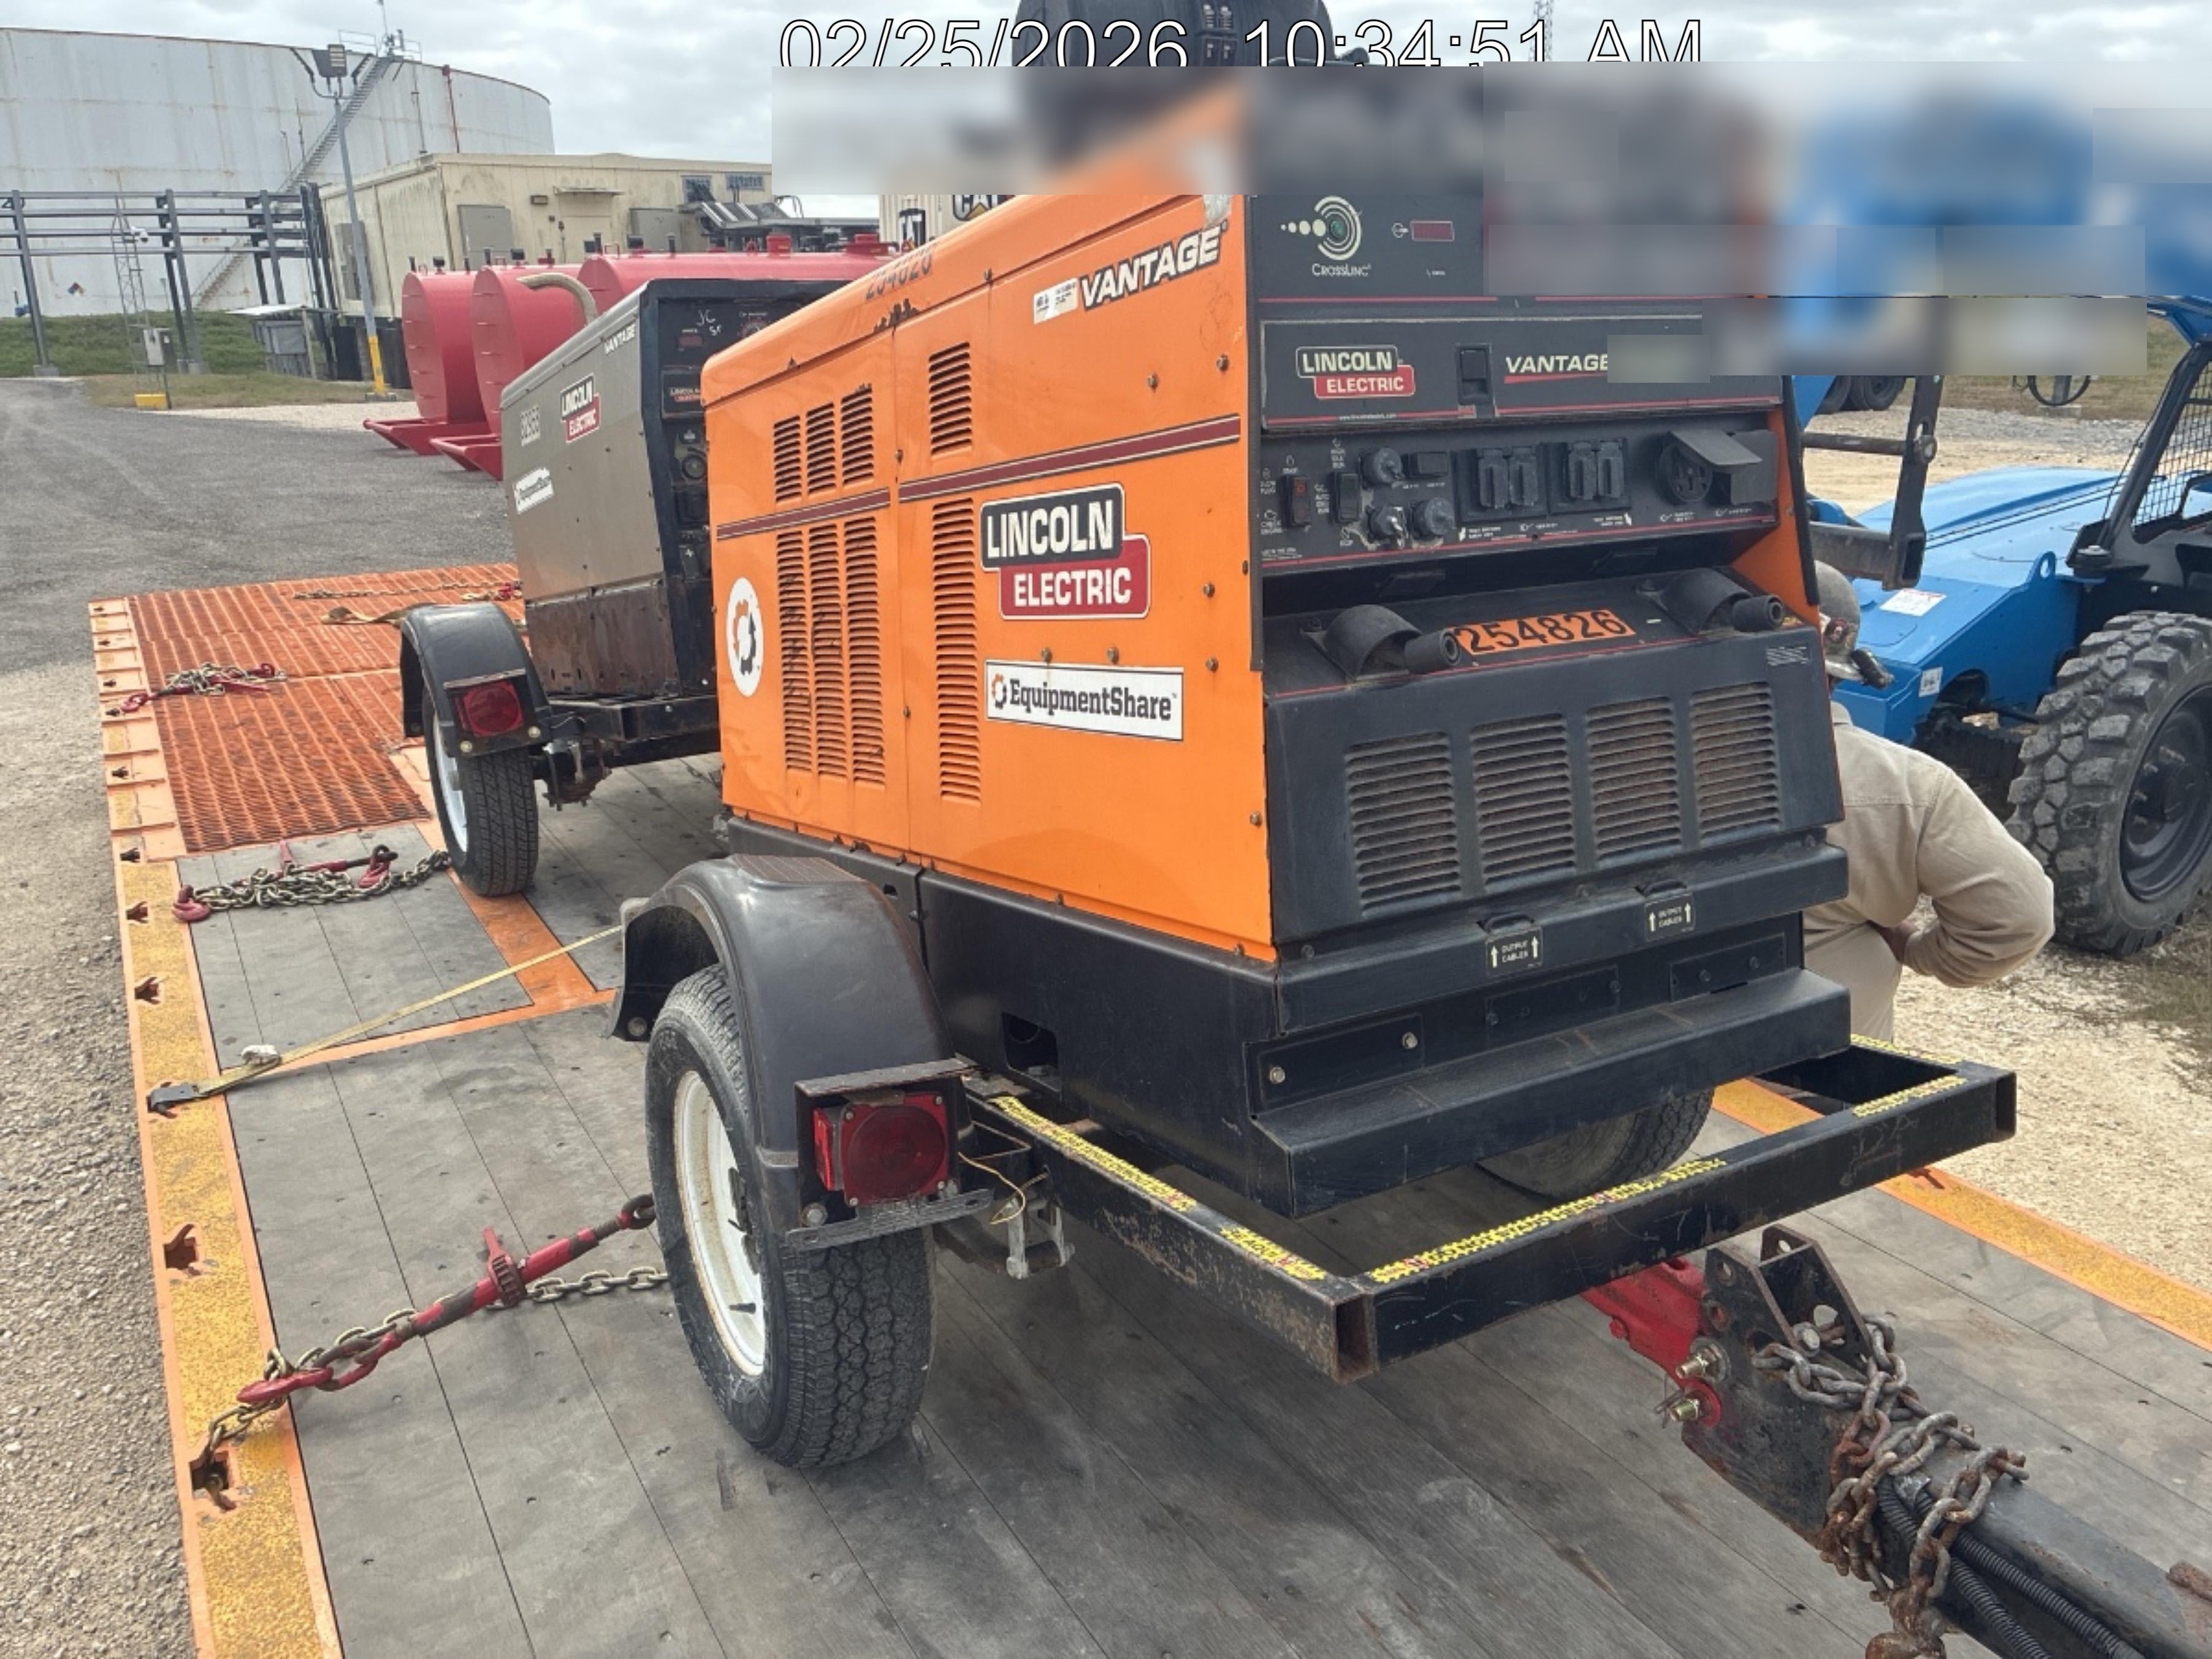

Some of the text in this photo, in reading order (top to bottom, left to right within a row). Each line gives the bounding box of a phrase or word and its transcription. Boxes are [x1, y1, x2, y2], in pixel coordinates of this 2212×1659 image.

[1080, 225, 1221, 310] VANTAGE
[1302, 351, 1392, 372] LINCOLN
[562, 379, 593, 418] LINCOLN
[1327, 376, 1405, 393] ELECTRIC
[987, 499, 1113, 559] LINCOLN
[1014, 567, 1132, 607] ELECTRIC
[1454, 611, 1627, 651] 254826
